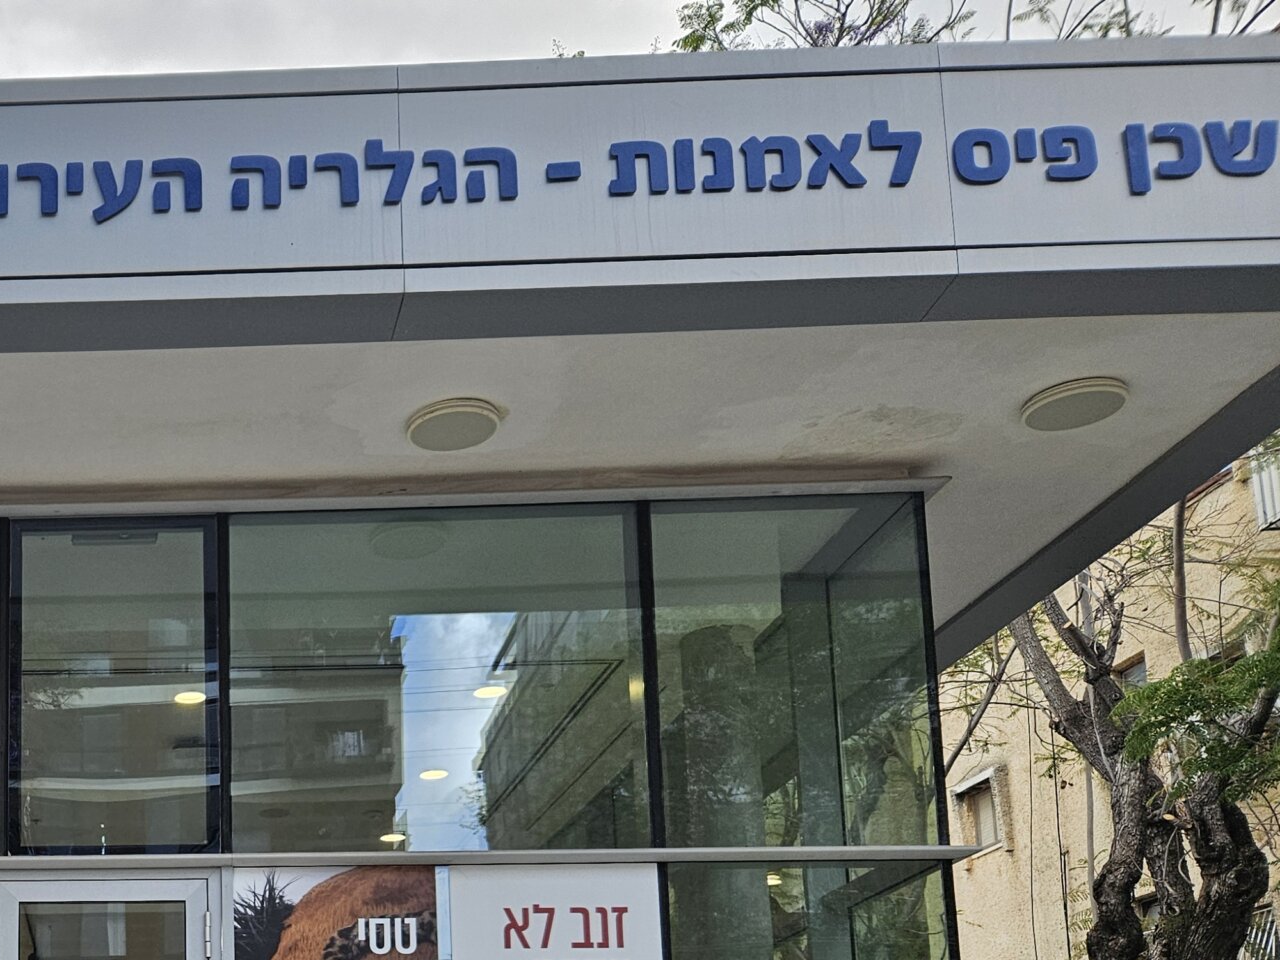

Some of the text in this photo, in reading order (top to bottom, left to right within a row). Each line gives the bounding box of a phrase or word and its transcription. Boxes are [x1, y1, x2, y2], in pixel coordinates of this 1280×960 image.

[230, 138, 519, 210] הגלריה
[608, 119, 923, 197] לאמנות
[952, 124, 1099, 185] פיס
[357, 917, 417, 955] טסי
[503, 903, 629, 949] זנב לא
